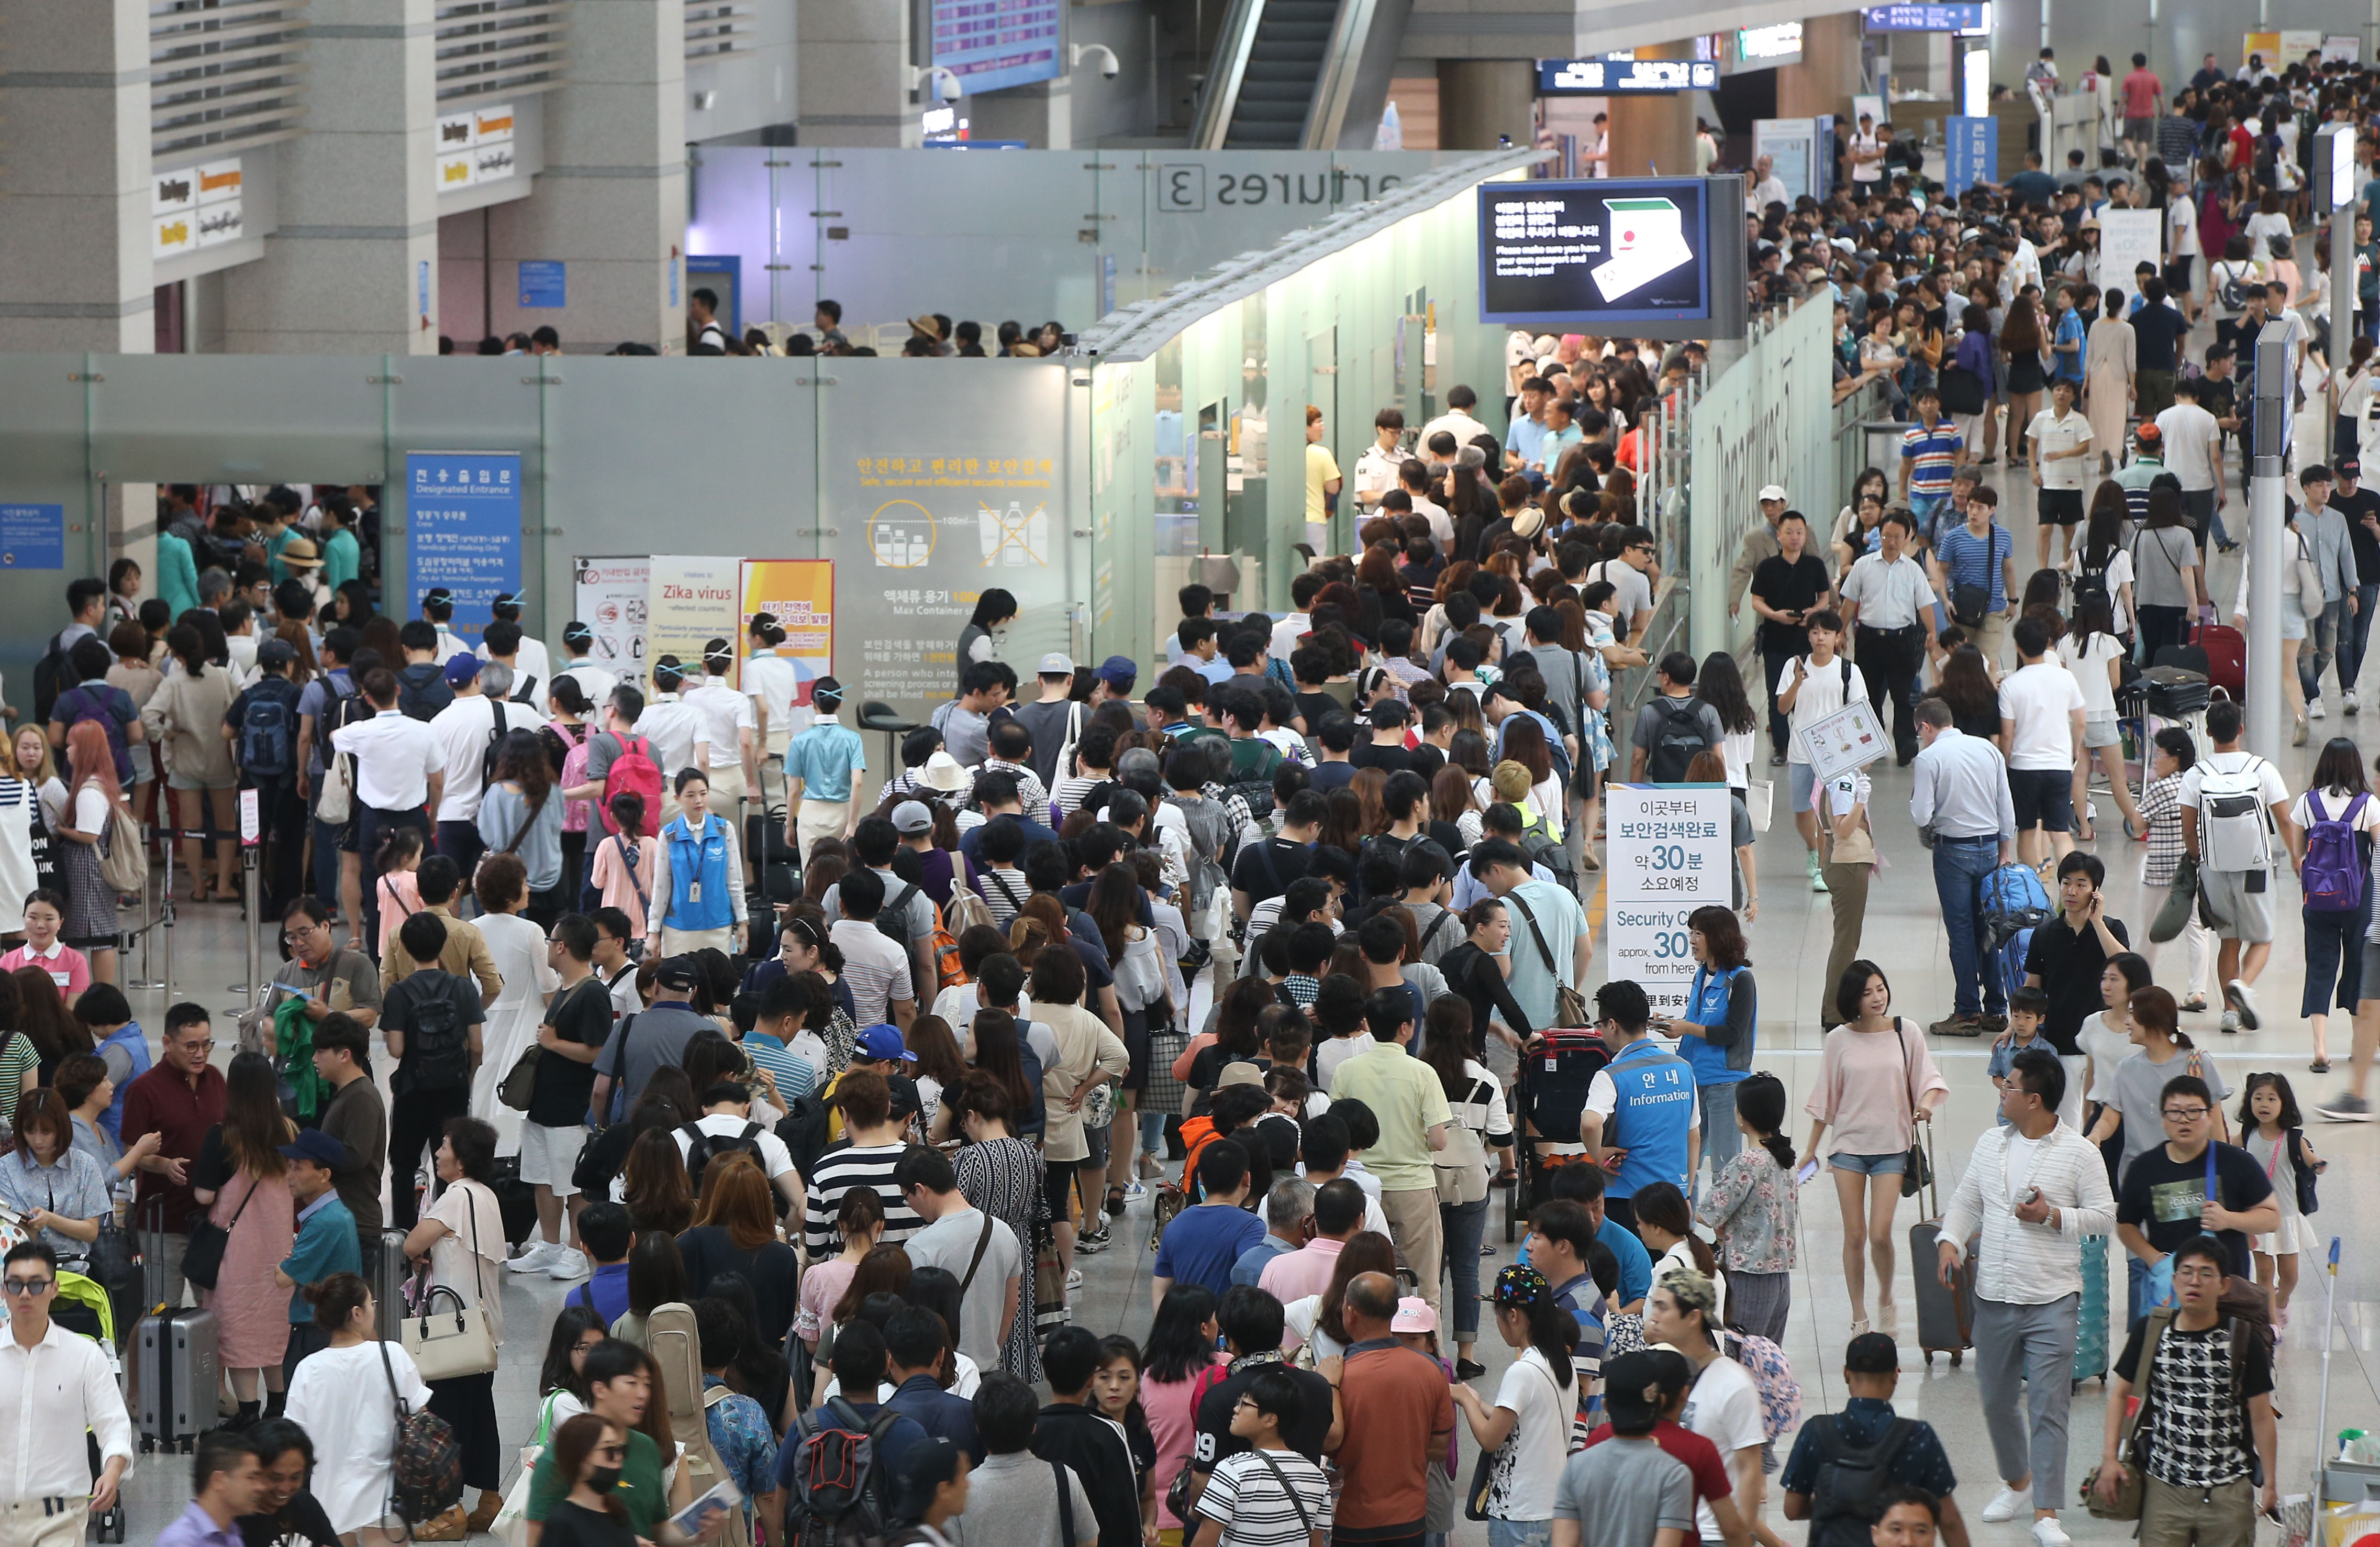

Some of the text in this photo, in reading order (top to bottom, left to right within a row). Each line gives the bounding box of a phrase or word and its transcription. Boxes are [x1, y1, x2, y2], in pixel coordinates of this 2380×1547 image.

[1526, 226, 1556, 238] 주시기
[1557, 225, 1599, 238] 바랍니다!
[1496, 243, 1601, 255] Please make sure you have
[1496, 257, 1515, 267] your
[1534, 255, 1570, 266] passport
[1570, 253, 1587, 263] and
[1496, 266, 1555, 277] boarding pass!
[857, 458, 1052, 474] 안전하고 편리한 보안검색
[860, 477, 1050, 488] Safe, secure and efficient security screening
[416, 485, 468, 495] Designated
[664, 585, 732, 600] Zika virus
[884, 590, 920, 603] 액체류
[925, 590, 948, 604] 용기
[762, 602, 811, 612] 터키 전역에
[894, 606, 913, 615] Max
[916, 606, 962, 615] Container
[811, 614, 829, 624] 발령
[864, 640, 913, 650] 보안검색을
[893, 653, 920, 662] 가하면
[864, 669, 872, 678] A
[875, 671, 909, 680] person
[912, 669, 934, 678] who
[864, 681, 905, 691] screening
[908, 681, 940, 691] process
[864, 689, 884, 699] shall
[887, 689, 897, 698] be
[900, 689, 924, 698] fined
[1640, 801, 1697, 815] 이곳부터
[1620, 822, 1718, 839] 보안검색완료
[31, 837, 48, 849] ON
[1634, 855, 1649, 870] 약
[1640, 876, 1698, 891] 소요예정
[1617, 911, 1674, 928] Security
[1654, 932, 1689, 958] 30
[1645, 962, 1696, 975] from here
[1630, 1089, 1690, 1106] Information
